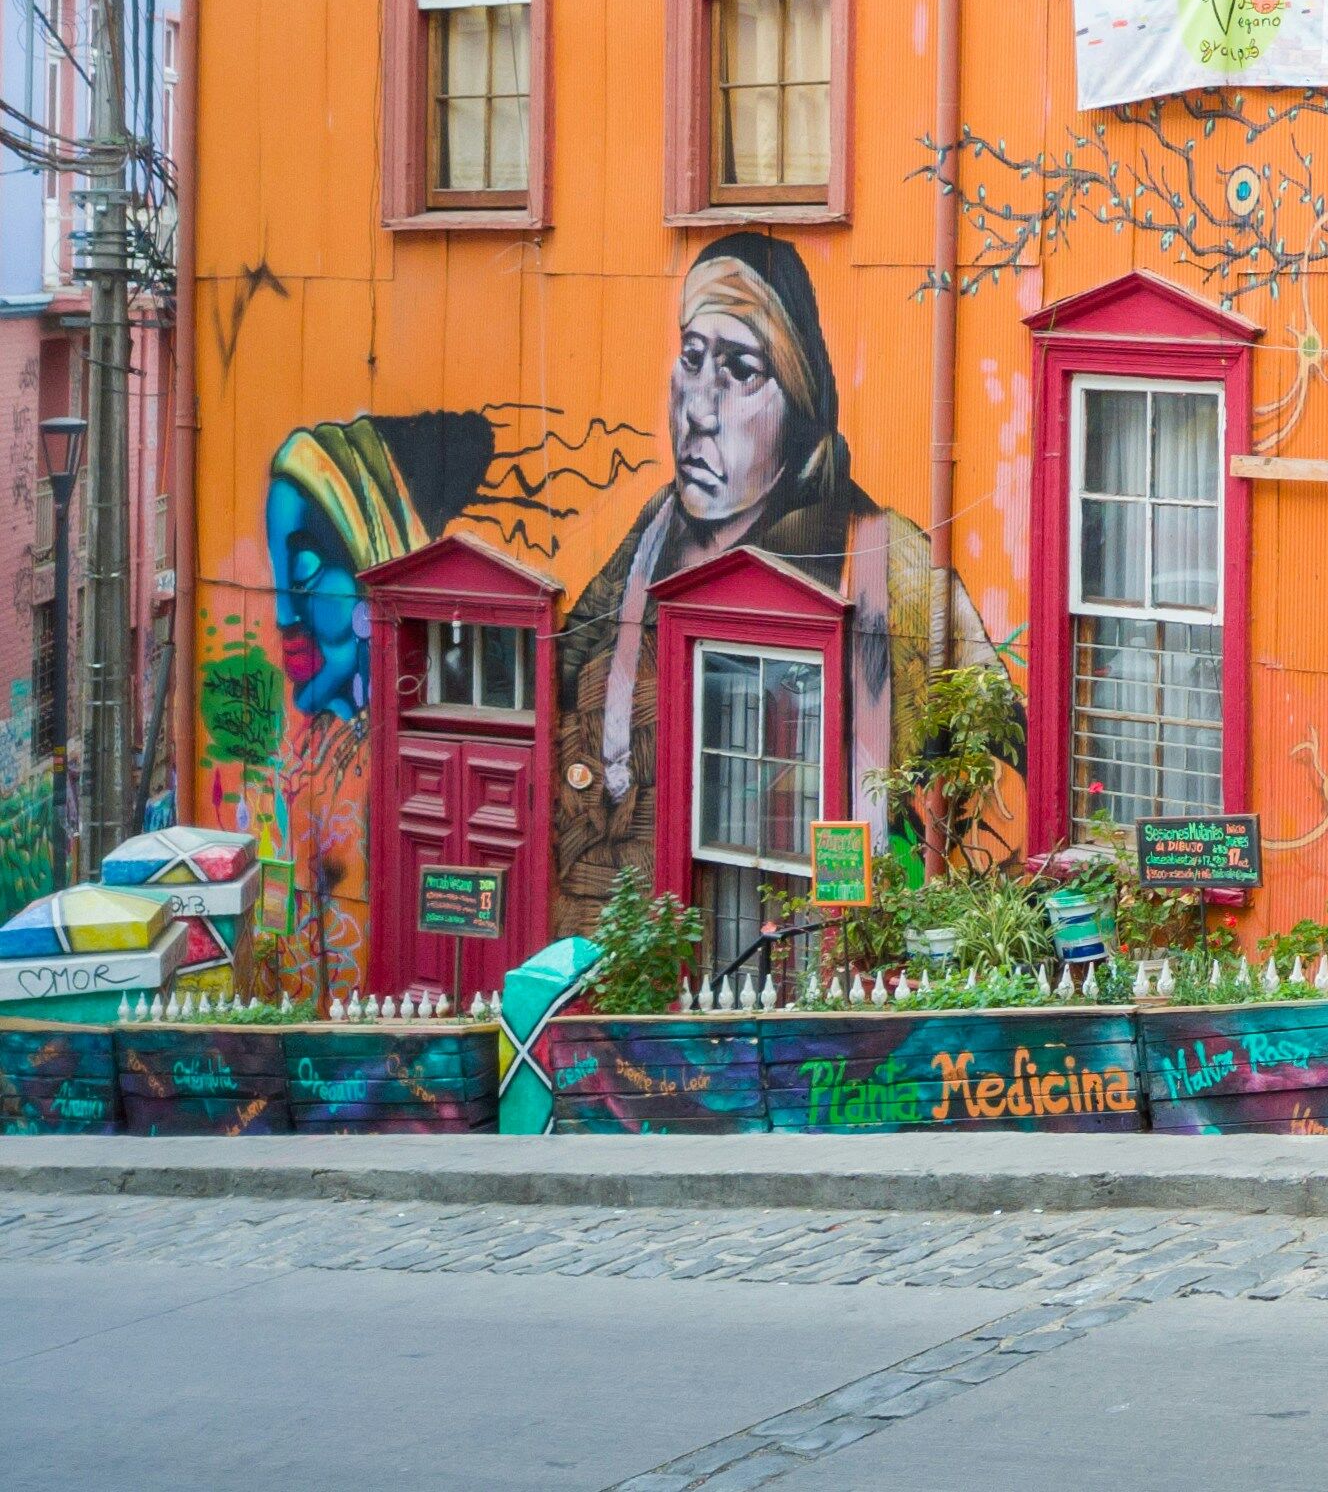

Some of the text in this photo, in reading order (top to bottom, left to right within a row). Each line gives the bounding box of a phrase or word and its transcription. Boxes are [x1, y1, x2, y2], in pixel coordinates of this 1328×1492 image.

[1144, 822, 1224, 842] Sesiones Mutantes
[1167, 841, 1204, 853] DIBUJO
[1228, 848, 1241, 866] 17
[481, 892, 492, 910] 13
[1162, 1032, 1311, 1106] Malva Rosa
[801, 1045, 1137, 1126] Planta Medicina
